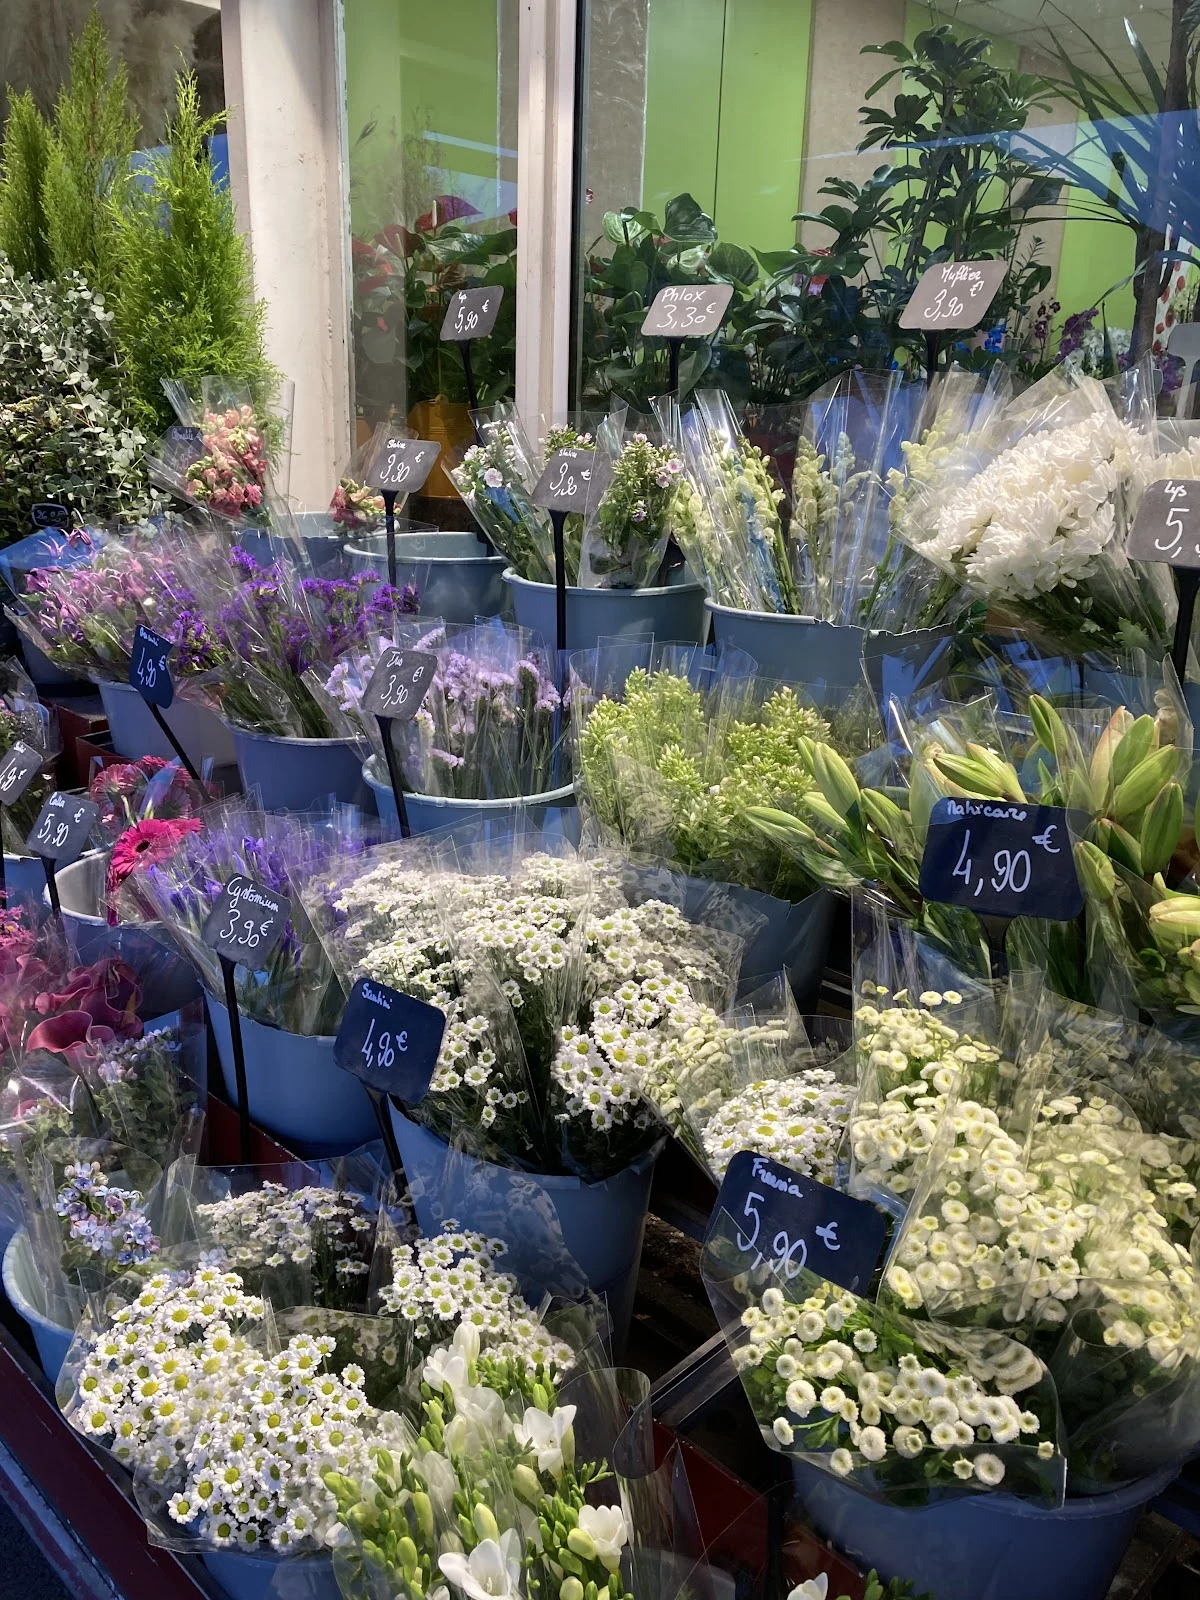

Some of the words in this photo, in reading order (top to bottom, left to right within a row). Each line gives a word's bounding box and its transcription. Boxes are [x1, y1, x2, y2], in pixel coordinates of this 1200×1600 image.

[661, 287, 707, 303] Phlox
[952, 828, 1032, 897] 4,90
[736, 1191, 808, 1280] 5,90
